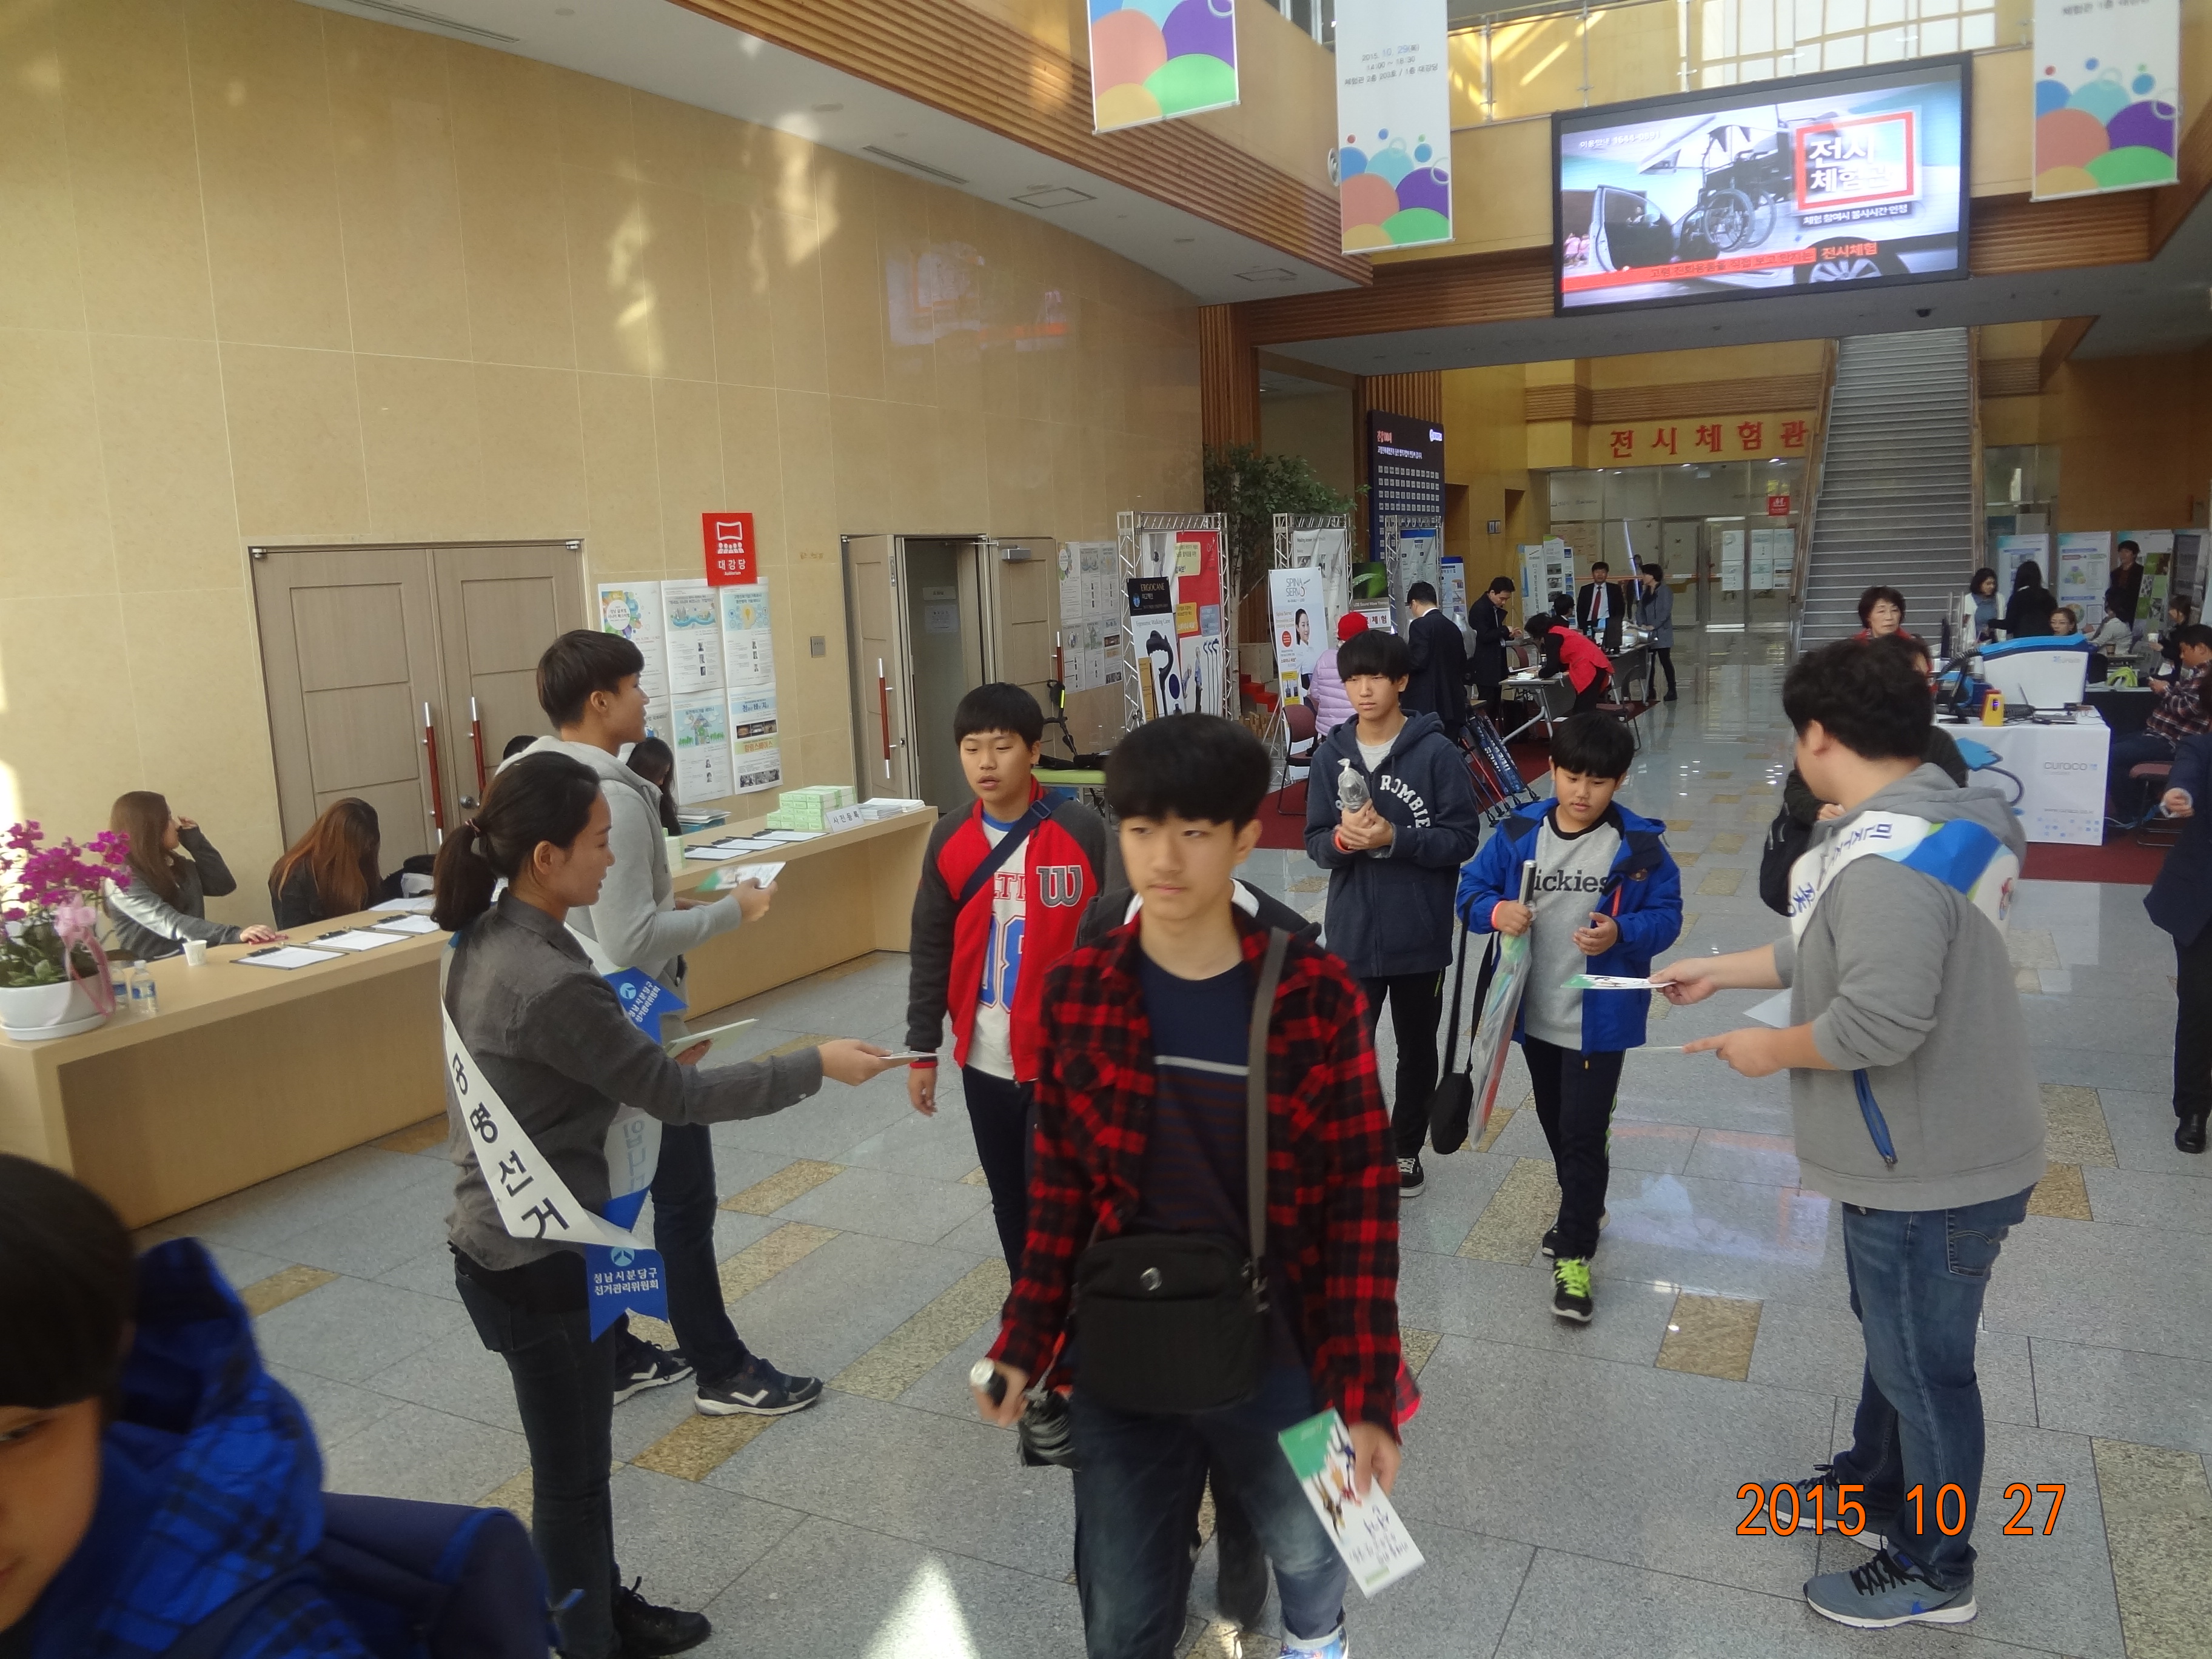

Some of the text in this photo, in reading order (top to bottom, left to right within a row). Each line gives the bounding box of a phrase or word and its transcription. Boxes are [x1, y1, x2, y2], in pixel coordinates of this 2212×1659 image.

[1362, 53, 1379, 61] 2015.
[1367, 62, 1386, 71] 14:00
[1396, 56, 1416, 65] 18:30
[1809, 135, 1875, 168] 전시
[1822, 241, 1878, 260] 전시체험
[1610, 419, 1809, 458] 전시체험관
[718, 558, 746, 571] 대강당
[1140, 582, 1165, 592] ERGOCANE
[1286, 578, 1303, 587] SPINA
[2044, 762, 2088, 771] curaco
[833, 811, 860, 825] 사전등록
[1534, 870, 1609, 894] ickies
[594, 1279, 659, 1296] 선거관리위원회
